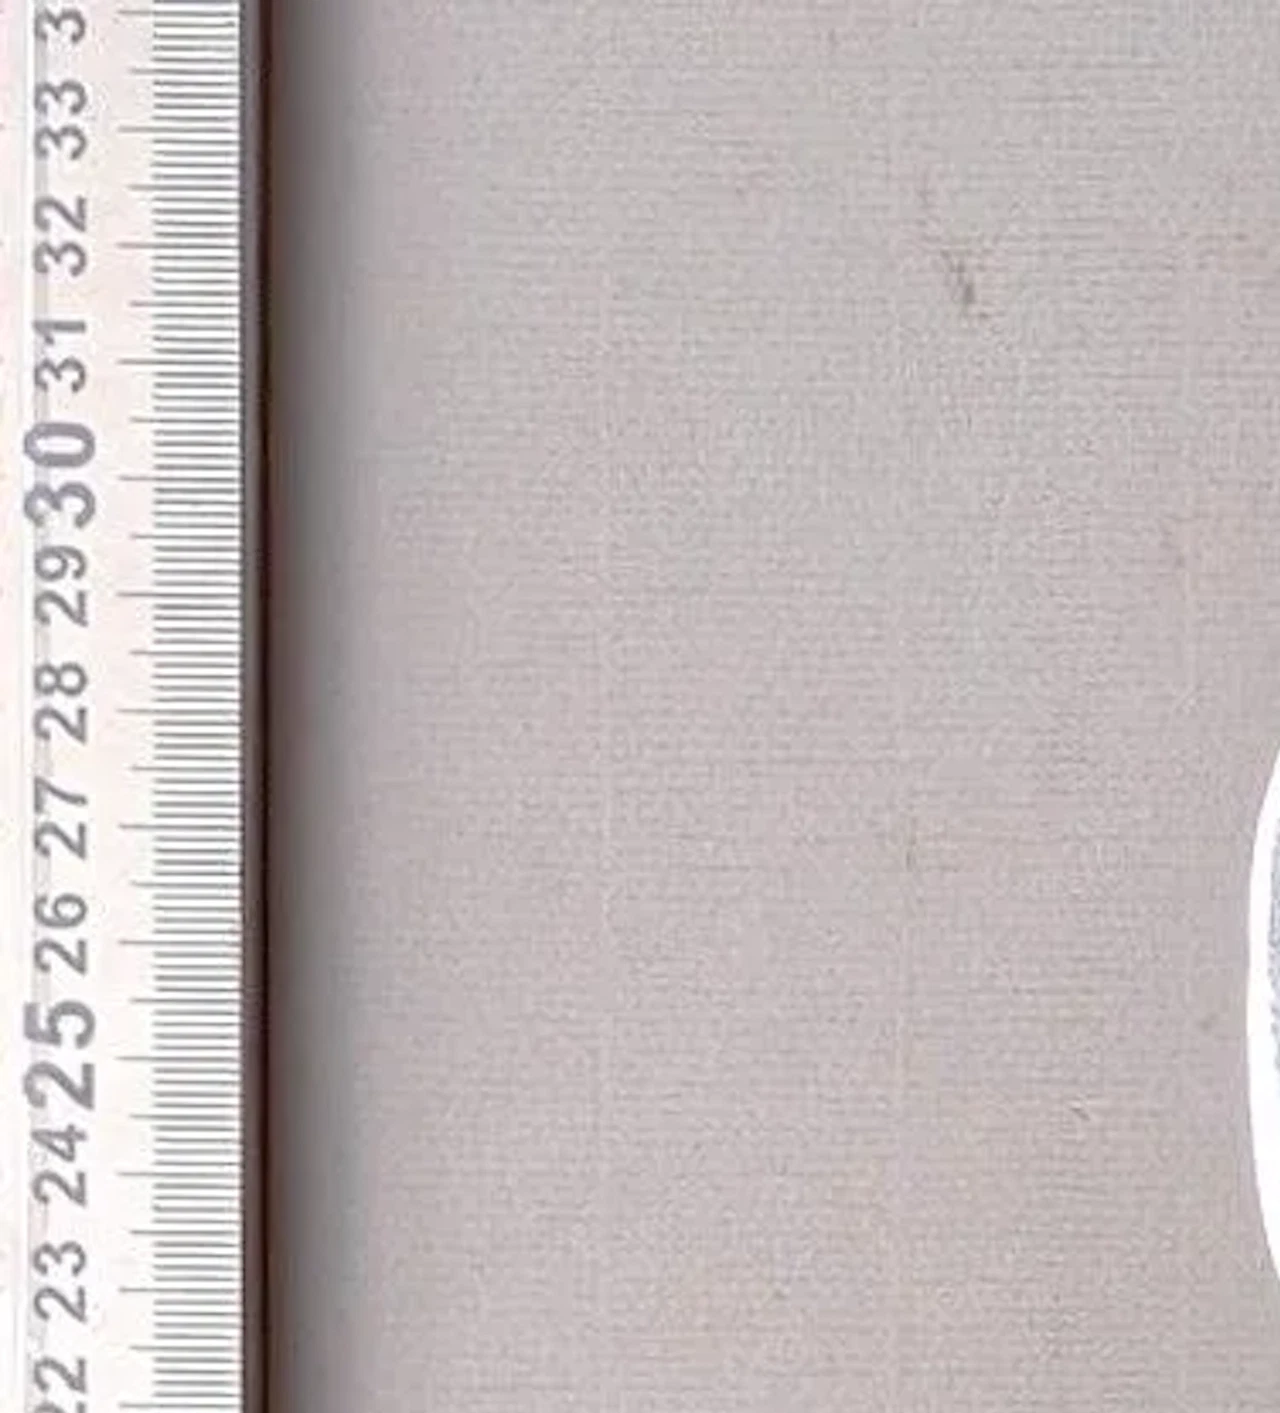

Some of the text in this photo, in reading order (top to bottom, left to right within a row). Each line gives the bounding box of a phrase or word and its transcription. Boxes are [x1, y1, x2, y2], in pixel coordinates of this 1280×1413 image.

[33, 80, 88, 161] 33
[32, 195, 88, 276] 32
[32, 318, 87, 397] 31
[22, 421, 96, 529] 30
[33, 545, 89, 627] 29
[32, 661, 89, 745] 28
[32, 774, 89, 861] 27
[32, 893, 88, 976] 26
[22, 1001, 96, 1111] 25
[30, 1124, 88, 1208] 24
[29, 1241, 88, 1324] 23
